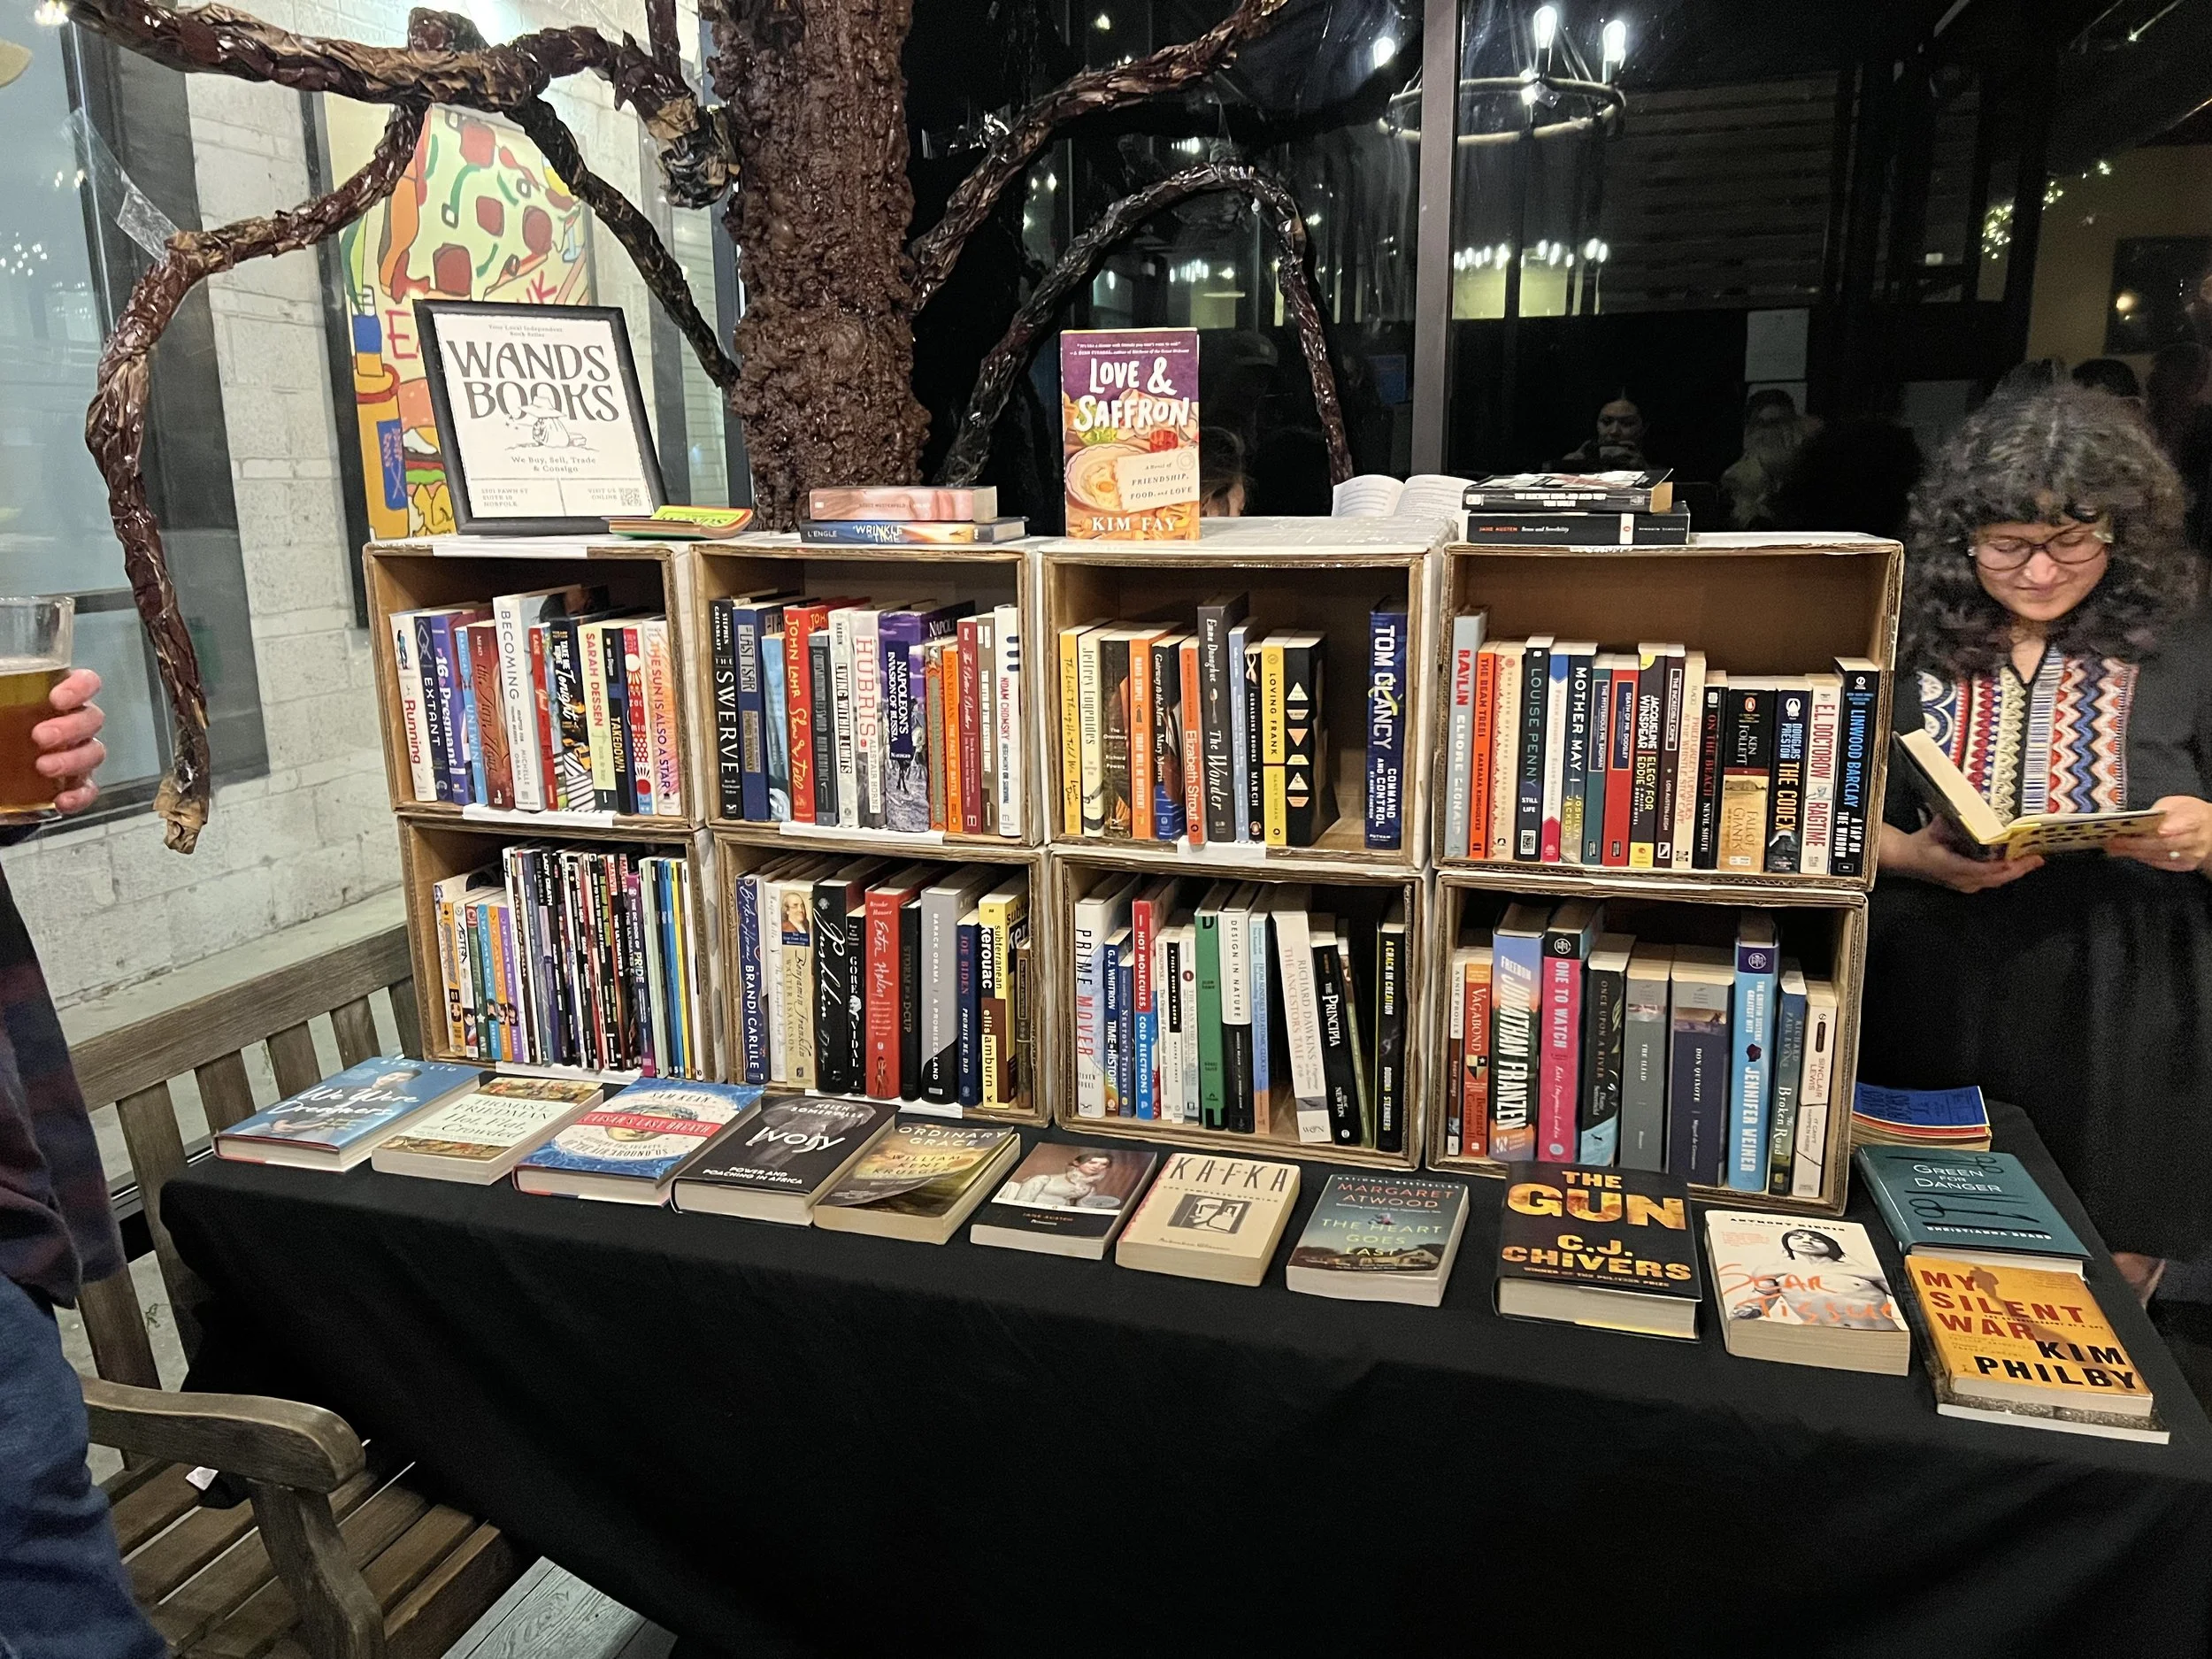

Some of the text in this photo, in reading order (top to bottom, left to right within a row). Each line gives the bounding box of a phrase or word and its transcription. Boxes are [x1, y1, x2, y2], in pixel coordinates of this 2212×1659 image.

[446, 340, 611, 381] WANDS
[1147, 356, 1178, 396] &
[464, 381, 620, 422] BOOKS
[1073, 395, 1190, 432] SAFFRON
[528, 457, 548, 465] Buy,
[549, 456, 568, 465] Sell,
[570, 456, 596, 465] Trade
[1132, 473, 1189, 486] FRIENDSHIP,
[1130, 489, 1156, 500] FOOD,
[856, 525, 902, 535] WRINKLE
[873, 534, 900, 543] TIME
[1092, 517, 1177, 531] KIM FAY
[501, 611, 518, 700] BECOMING
[651, 643, 661, 666] THE
[785, 616, 800, 660] JOHN
[556, 670, 577, 719] Tonight
[586, 634, 603, 726] SARAH DESSEN
[653, 672, 663, 697] SUN
[788, 665, 801, 697] LAHR
[856, 639, 875, 735] HUBRIS
[887, 651, 898, 742] INVASION OF RUSSIA
[896, 661, 908, 734] NAPOLEON'S
[1372, 626, 1395, 749] TOM CLANCY
[424, 677, 441, 746] EXTANT
[435, 657, 457, 766] 16 Pregnant
[655, 699, 664, 709] IS
[836, 663, 851, 773] LIVING WITHIN LIMITS
[1269, 672, 1279, 755] LOVING FRANK
[1572, 667, 1587, 734] MOTHER
[404, 700, 422, 764] Running
[466, 704, 480, 769] UNTWINE
[656, 712, 666, 745] ALSO
[715, 671, 738, 773] SWERVE
[788, 704, 807, 740] Show
[1001, 703, 1010, 740] CHOMSKY
[1525, 668, 1542, 787] LOUISE PENNY
[1637, 695, 1650, 749] WINSPEAR
[1647, 695, 1660, 749] JACQUELINE
[611, 717, 625, 772] TAKEDOWN
[1156, 733, 1165, 782] Mary Morris
[1570, 740, 1583, 772] MAY
[1736, 726, 1749, 765] FOLLETT
[1747, 735, 1758, 755] KEN
[1844, 710, 1866, 807] LINWOOD BARCLAY
[660, 759, 670, 788] STAR
[794, 759, 806, 790] Tell
[1185, 730, 1200, 821] Elizabeth Strout
[1207, 730, 1228, 810] The Wonder
[1635, 756, 1646, 785] EDDIE
[1644, 757, 1656, 810] ELEGY FOR
[1805, 704, 1835, 847] E.L. DOCTOROW RAGTIME
[1375, 777, 1386, 827] CONTROL
[1386, 768, 1396, 818] COMMAND
[1775, 762, 1800, 832] THE CODEX
[544, 878, 553, 906] DEATH
[634, 952, 644, 983] PRIDE
[813, 908, 845, 1022] Pushkin
[995, 925, 1003, 989] subterranean
[1232, 963, 1239, 973] IN
[1385, 948, 1394, 971] CRACK
[1076, 929, 1094, 1056] PRIME MOVER
[1138, 954, 1147, 1010] MOLECULES,
[1384, 981, 1394, 1015] CREATION
[745, 964, 759, 1069] BRANDI CARLILE
[981, 925, 995, 1087] kerouac ellis amburn
[1471, 988, 1486, 1051] VAGABOND
[1498, 974, 1530, 1057] JONATHAN
[1553, 961, 1569, 1048] ONE TO WATCH
[1496, 1062, 1528, 1131] FRANZEN
[898, 1126, 1008, 1141] ORDINARY
[1740, 1066, 1760, 1171] JENNIFER WEINER
[1773, 1087, 1792, 1156] Broken Road
[909, 1136, 978, 1148] GRACE
[1169, 1156, 1289, 1193] KAFKA
[1336, 1182, 1456, 1199] MARGARET
[1562, 1171, 1623, 1189] THE
[1912, 1164, 1985, 1178] GREEN
[1914, 1177, 2002, 1194] DANGER
[1341, 1194, 1439, 1209] ATWOOD
[1506, 1182, 1686, 1231] GUN
[1730, 1217, 1793, 1226] ANTHONY
[1322, 1218, 1442, 1235] THE HEART
[1345, 1234, 1407, 1245] GOES
[1556, 1234, 1633, 1256] C.J.
[1344, 1246, 1397, 1258] LAST
[1502, 1246, 1692, 1281] CHIVERS
[1919, 1270, 1977, 1291] MY
[1929, 1293, 2084, 1324] SILENT
[1935, 1312, 2037, 1340] WAR
[1973, 1356, 2139, 1389] PHILBY
[2039, 1340, 2127, 1365] KIM
